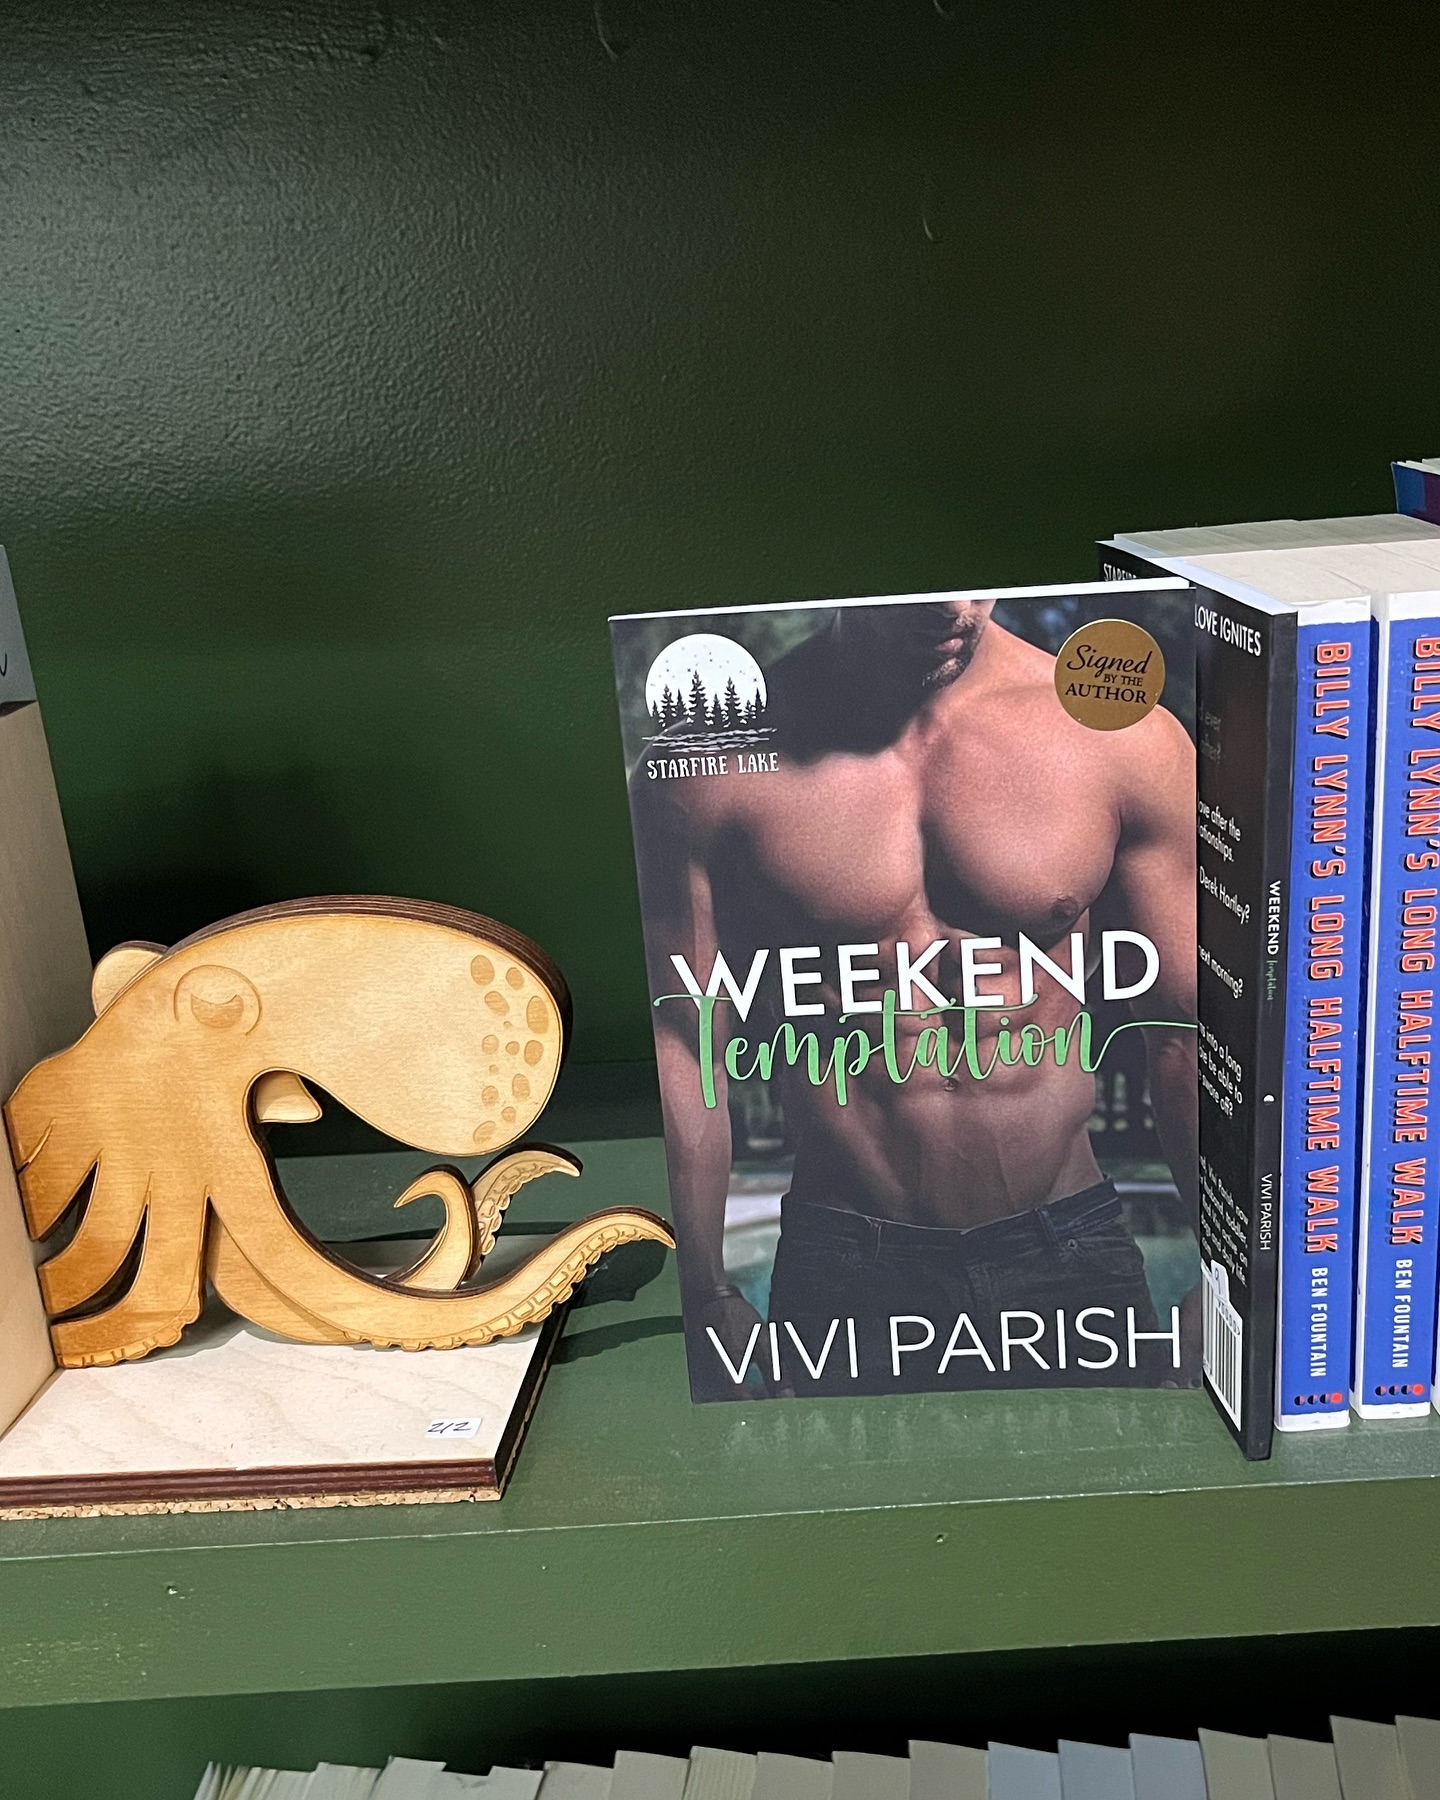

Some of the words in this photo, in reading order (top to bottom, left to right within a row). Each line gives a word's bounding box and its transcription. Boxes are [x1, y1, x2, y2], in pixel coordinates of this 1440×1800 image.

[1066, 644, 1153, 678] Signed
[1194, 604, 1218, 636] LOVE
[1219, 615, 1262, 657] IGNITES
[1065, 682, 1147, 705] AUTHOR
[1103, 673, 1118, 684] BY
[1121, 675, 1144, 687] THE
[1315, 641, 1352, 738] BILLY
[1411, 636, 1440, 730] BILLY
[646, 755, 729, 780] STARFIRE
[737, 752, 780, 774] LAKE
[1210, 805, 1228, 831] after
[1228, 816, 1241, 842] the
[1310, 754, 1349, 878] LYNN'S
[1404, 747, 1440, 870] LYNN'S
[1199, 865, 1219, 898] Derek
[1267, 880, 1281, 956] WEEKEND
[1309, 895, 1346, 980] LONG
[1401, 888, 1438, 973] LONG
[669, 929, 1161, 1023] WEEKEND
[1210, 957, 1244, 999] morning?
[653, 990, 1199, 1109] Temptation
[1224, 1046, 1242, 1082] long
[1306, 996, 1343, 1151] HALFTIME
[1394, 989, 1434, 1143] HALFTIME
[1233, 1084, 1243, 1105] to
[1260, 1173, 1273, 1199] VIVI
[1305, 1165, 1340, 1253] WALK
[1390, 1157, 1427, 1244] WALK
[1259, 1202, 1272, 1251] PARISH
[1311, 1267, 1329, 1297] BEN
[1394, 1258, 1413, 1289] BEN
[705, 1316, 860, 1385] VIVI
[889, 1305, 1182, 1377] PARISH
[1310, 1303, 1328, 1377] FOUNTAIN
[1392, 1294, 1412, 1368] FOUNTAIN
